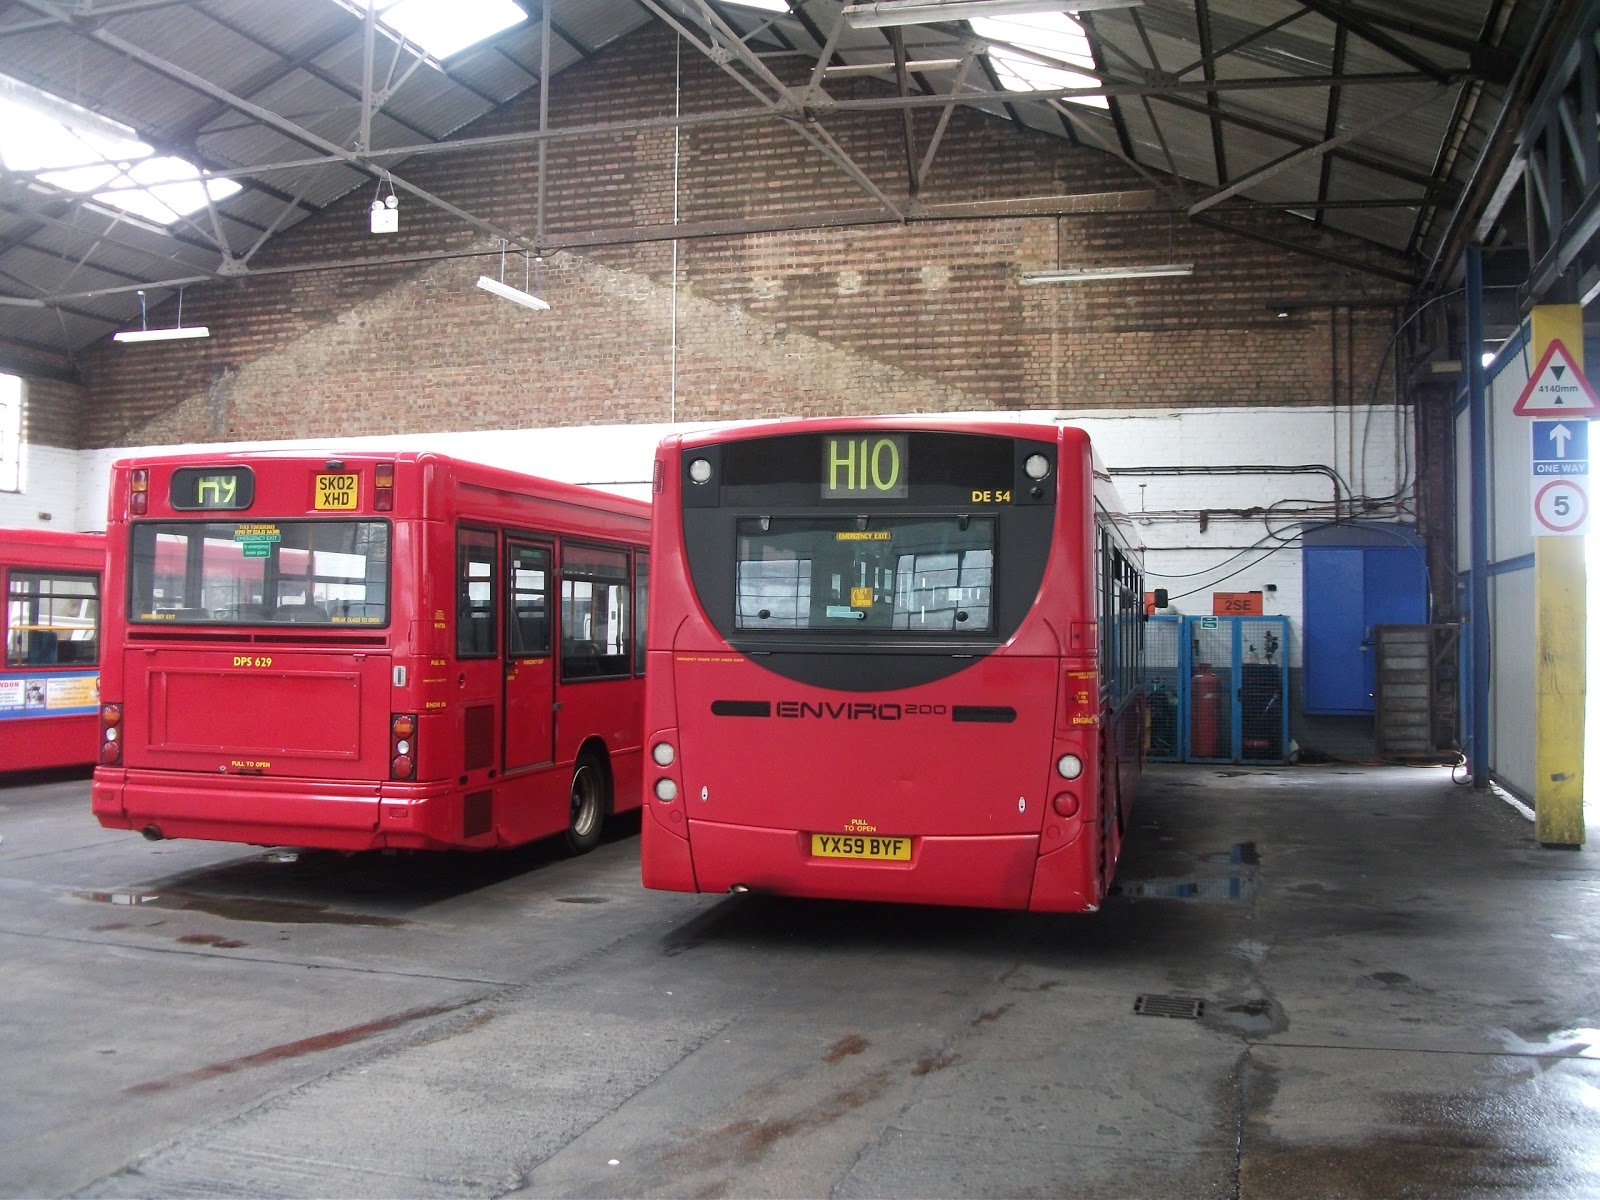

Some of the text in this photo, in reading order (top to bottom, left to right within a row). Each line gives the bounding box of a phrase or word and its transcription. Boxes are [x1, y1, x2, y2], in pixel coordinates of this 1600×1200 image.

[1538, 384, 1579, 393] 4140mm
[829, 438, 900, 491] H10
[1536, 464, 1586, 473] ONE WAY
[319, 476, 354, 491] SK02
[323, 492, 350, 506] XHD
[971, 490, 1011, 502] DE 54
[1554, 495, 1570, 516] 5
[838, 532, 888, 540] EMERGENCY EXIT
[233, 656, 272, 667] DPS 629
[776, 701, 947, 720] ENVIRO 200
[820, 836, 904, 855] YX59 BYF
